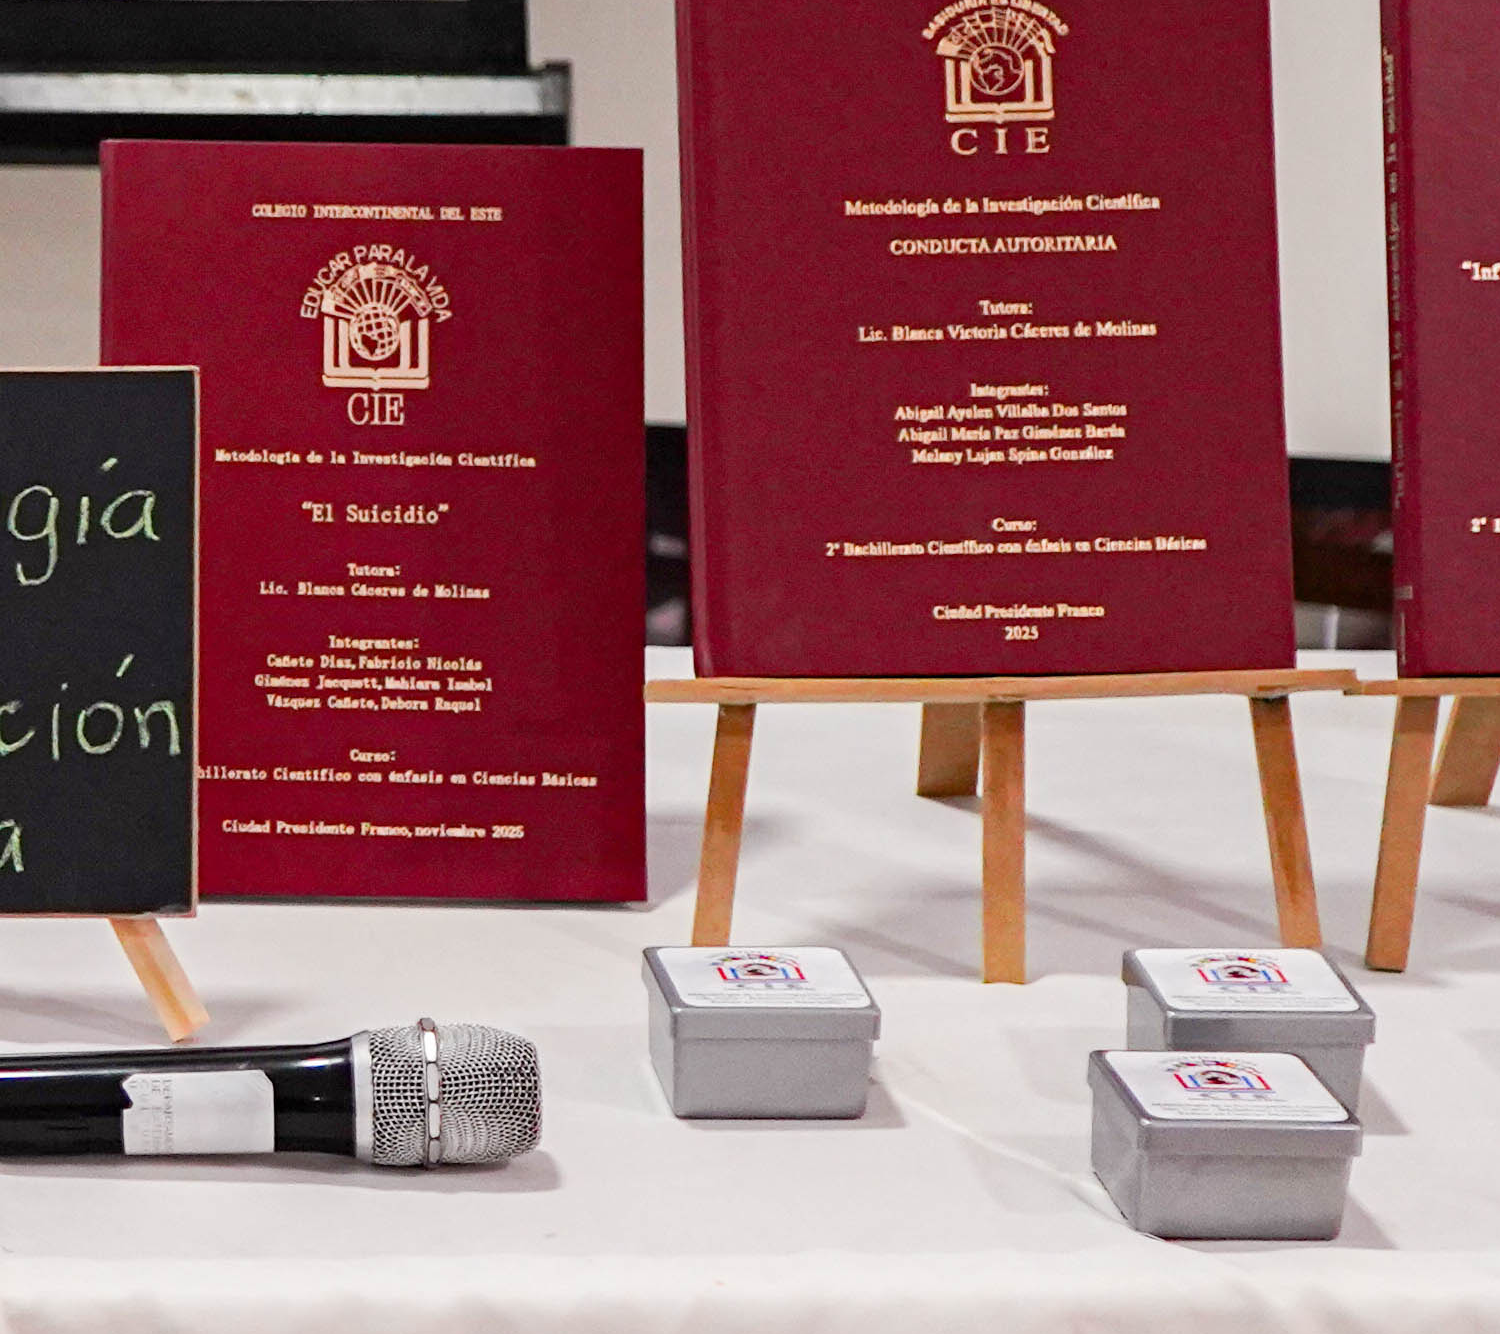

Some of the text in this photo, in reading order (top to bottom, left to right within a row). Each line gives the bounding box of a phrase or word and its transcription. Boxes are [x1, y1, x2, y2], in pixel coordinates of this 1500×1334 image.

[950, 127, 1051, 155] CIE
[251, 204, 503, 221] COLEGIO INTERCONTINENTAL DEL ESTE
[942, 198, 962, 213] de
[964, 198, 980, 213] la
[889, 235, 1118, 255] CONDUCTA AUTORITARIA
[299, 244, 454, 323] EDUCAR PARA LA VIDA
[857, 327, 888, 342] Lic.
[1073, 321, 1092, 337] de
[1095, 320, 1158, 336] Molinas
[347, 393, 405, 425] CIE
[1051, 403, 1080, 417] Dos
[306, 451, 324, 463] de
[329, 451, 346, 464] la
[346, 563, 401, 577] Tutora:
[259, 581, 289, 595] Lic.
[412, 584, 430, 597] de
[1004, 626, 1039, 640] 2025
[328, 635, 420, 651] Integrantes:
[349, 749, 396, 762] Curso:
